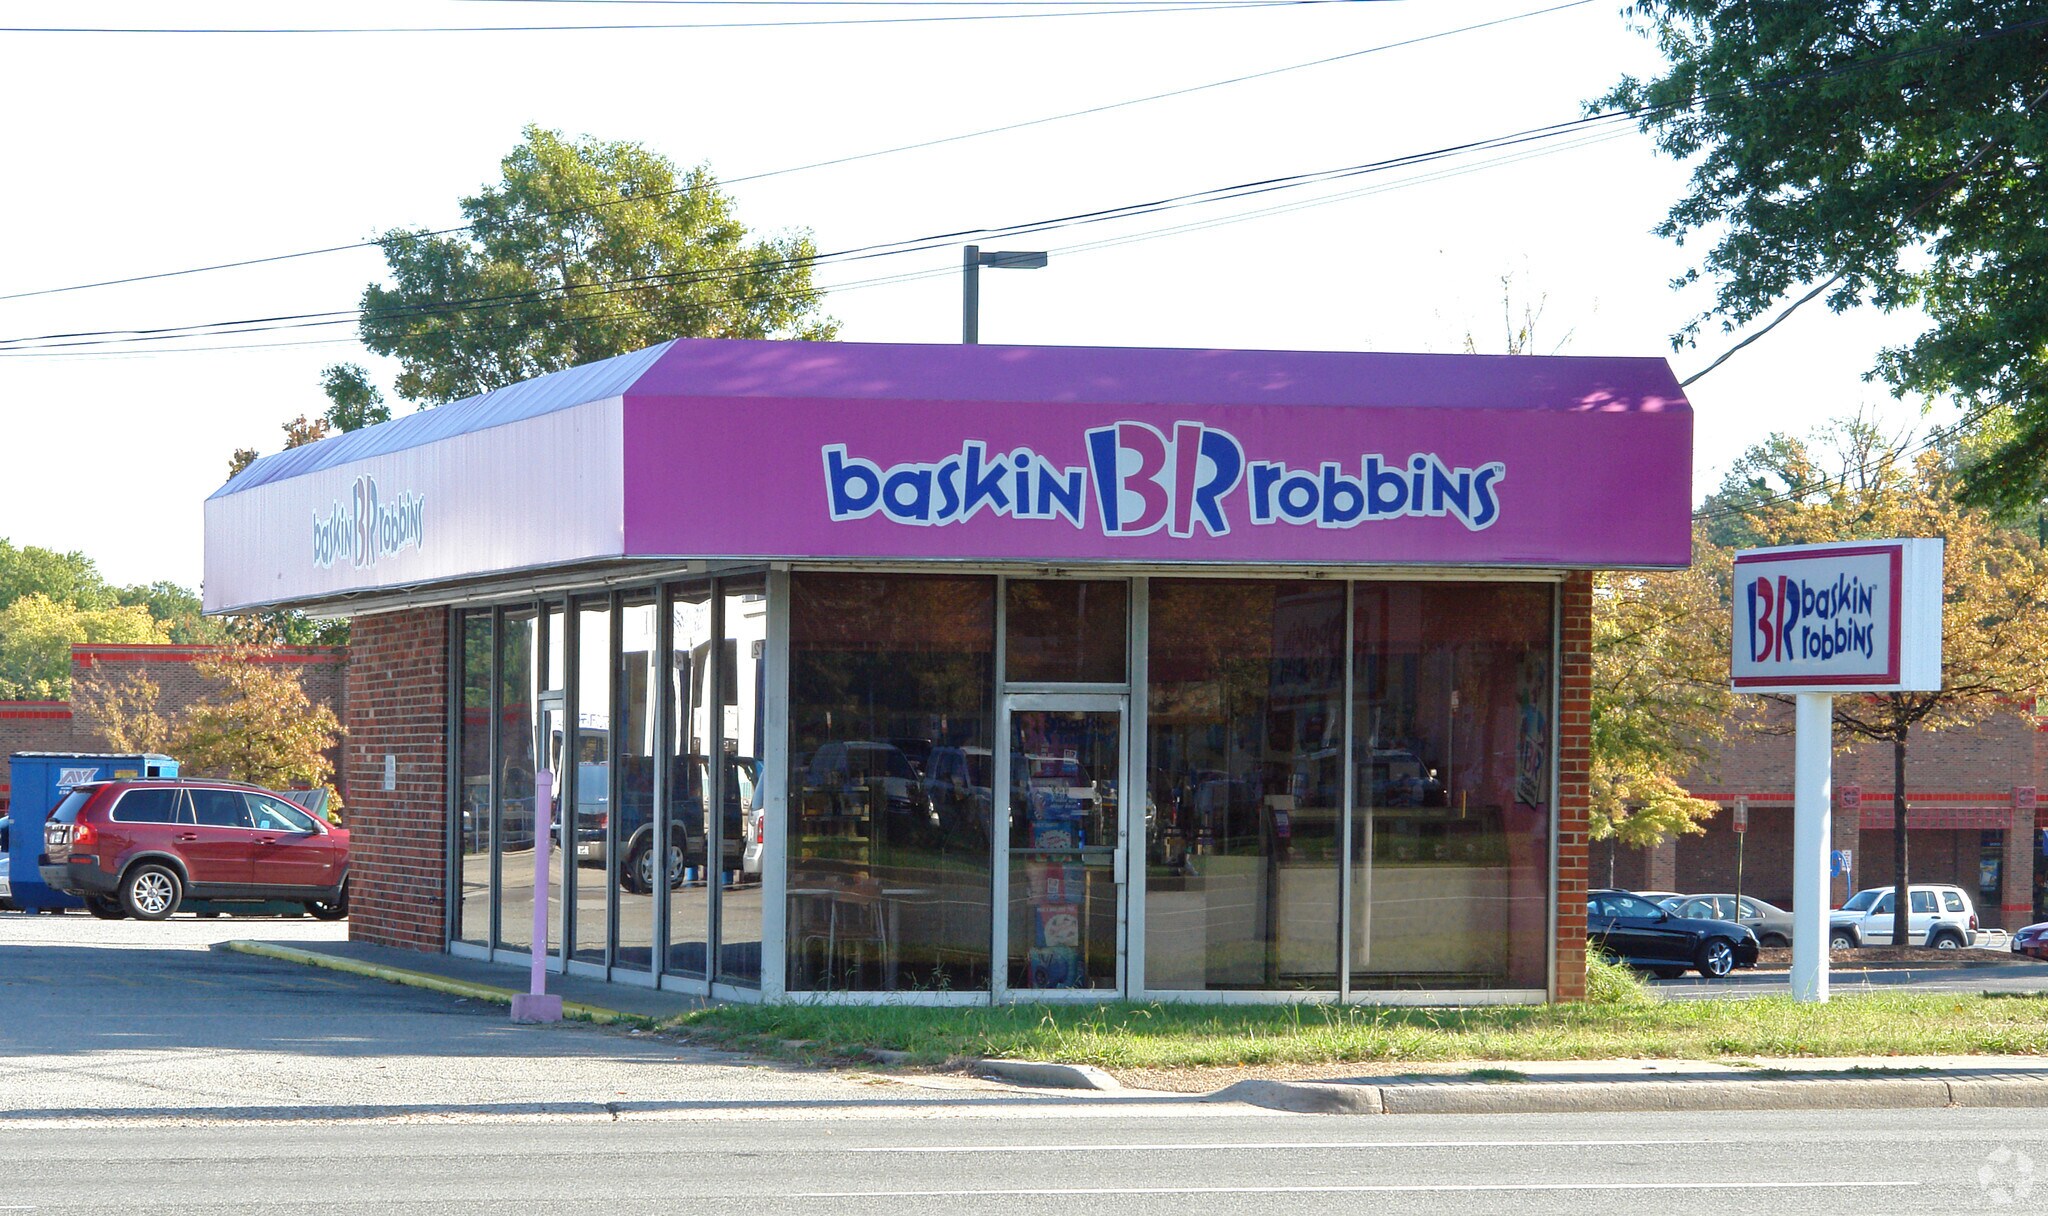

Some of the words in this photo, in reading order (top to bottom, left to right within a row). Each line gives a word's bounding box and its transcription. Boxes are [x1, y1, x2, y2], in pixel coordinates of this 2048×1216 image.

[352, 475, 378, 567] BR
[1088, 424, 1241, 533] BR
[1747, 575, 1800, 663] BR
